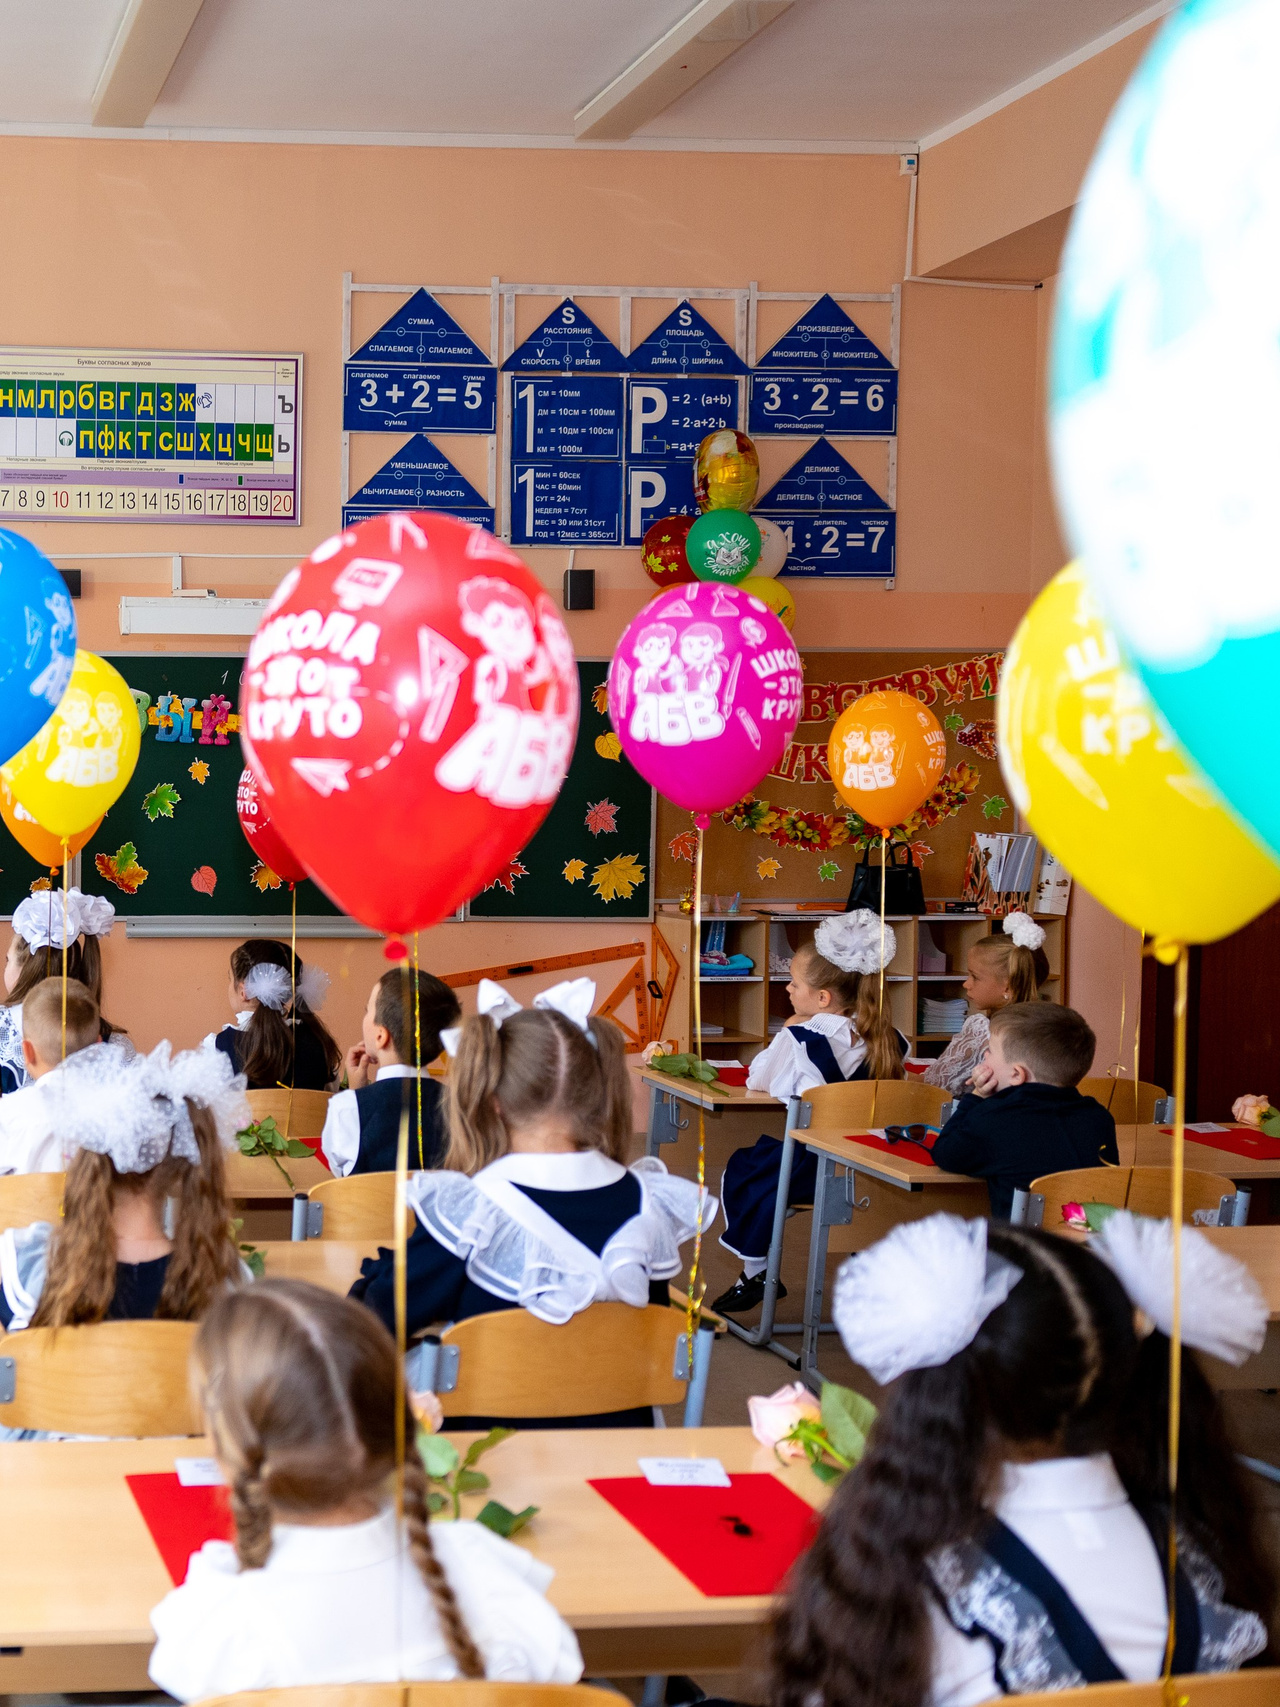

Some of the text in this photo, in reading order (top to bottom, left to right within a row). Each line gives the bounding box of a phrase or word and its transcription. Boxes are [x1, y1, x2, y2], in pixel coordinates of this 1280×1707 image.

[562, 307, 575, 324] S
[666, 329, 704, 337] ПЛОЩАДЬ
[679, 309, 692, 326] S
[519, 384, 534, 453] 1
[1, 490, 9, 506] 7
[19, 490, 27, 507] 8
[36, 491, 45, 507] 9
[53, 491, 68, 508] 10
[76, 492, 90, 508] 11
[97, 492, 113, 509] 12
[120, 492, 135, 509] 13
[142, 493, 157, 509] 14
[164, 493, 180, 510] 15
[186, 493, 202, 510] 16
[208, 494, 224, 510] 17
[231, 494, 246, 511] 18
[253, 495, 268, 511] 19
[273, 495, 291, 512] 20
[518, 468, 534, 537] 1
[29, 650, 75, 708] АБ
[750, 648, 802, 679] ШКОЛ
[248, 695, 364, 741] КРУТО
[629, 691, 725, 746] АБВ
[761, 697, 801, 721] КРУ
[45, 748, 120, 788] АБВ
[433, 702, 569, 810] АБВ
[842, 763, 896, 790] АБВ
